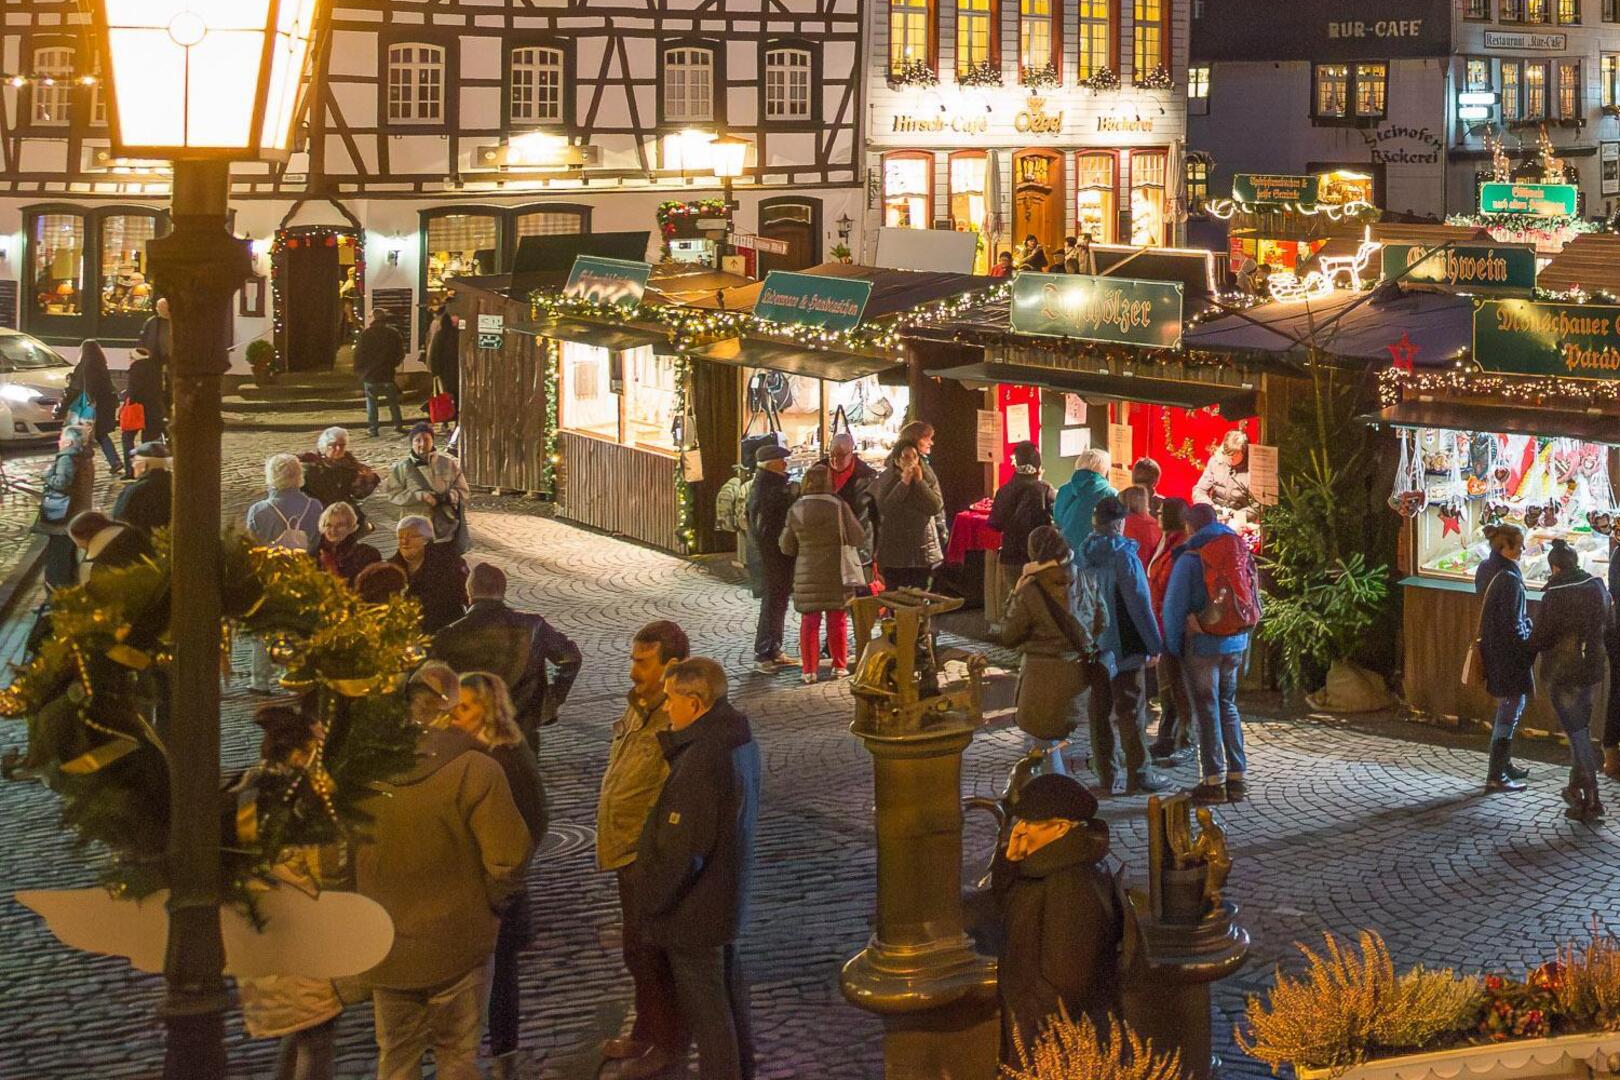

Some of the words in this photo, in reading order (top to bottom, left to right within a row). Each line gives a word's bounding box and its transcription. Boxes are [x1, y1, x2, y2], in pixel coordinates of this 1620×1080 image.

[1360, 125, 1443, 150] Steinofen
[1371, 148, 1438, 163] Bäckerei
[1406, 247, 1508, 286] Gühwein
